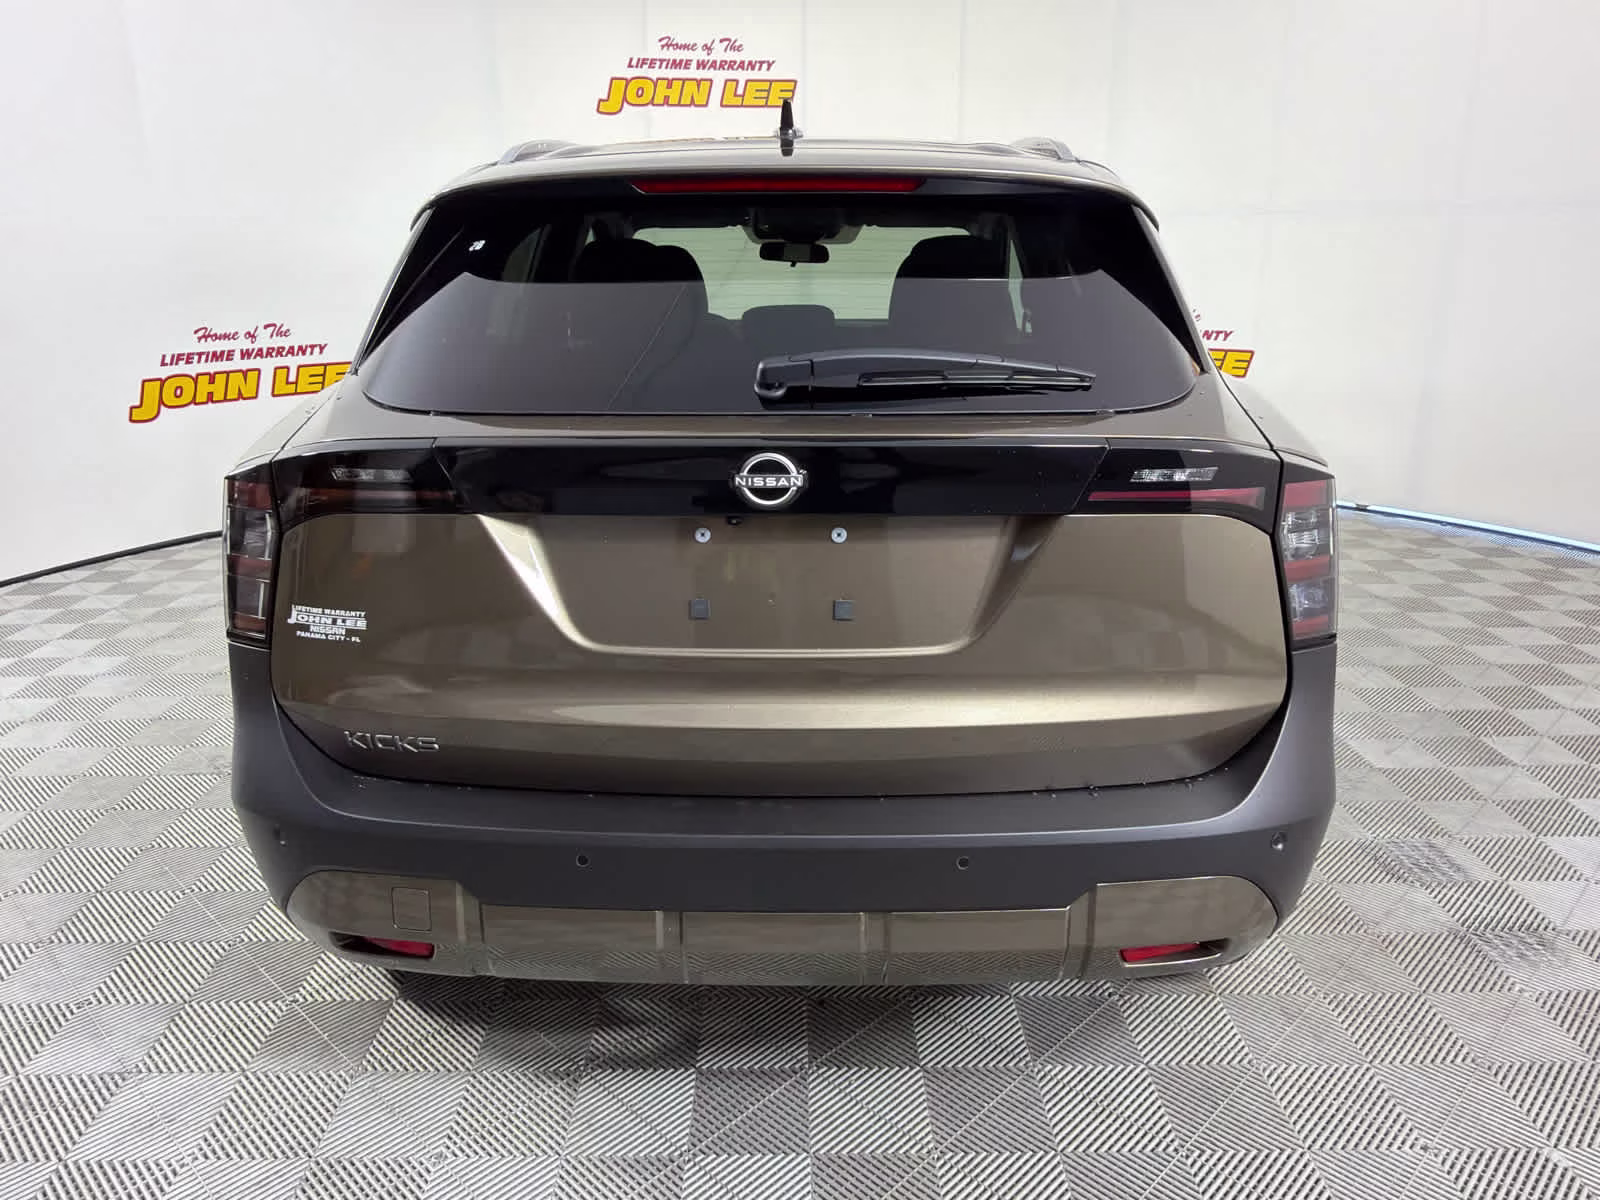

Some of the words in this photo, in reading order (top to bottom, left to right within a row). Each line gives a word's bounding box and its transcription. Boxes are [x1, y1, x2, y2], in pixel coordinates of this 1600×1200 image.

[658, 36, 698, 51] Home
[701, 39, 714, 55] of
[719, 37, 744, 53] The
[627, 57, 693, 70] LIFETIME
[695, 59, 775, 71] WARRANTY
[597, 76, 713, 115] JOHN
[720, 79, 797, 108] LEE
[193, 326, 240, 343] Home
[244, 326, 259, 344] of
[263, 323, 292, 339] The
[160, 349, 235, 367] LIFETIME
[239, 343, 327, 361] WARRANTY
[129, 368, 261, 423] JOHN
[735, 477, 803, 487] NISSAN
[287, 604, 333, 624] JOHN
[336, 618, 367, 627] LEE
[324, 608, 366, 617] WARRANTY
[296, 630, 326, 639] PANAMA
[310, 624, 346, 635] NISSAN
[344, 730, 440, 753] KICKS
